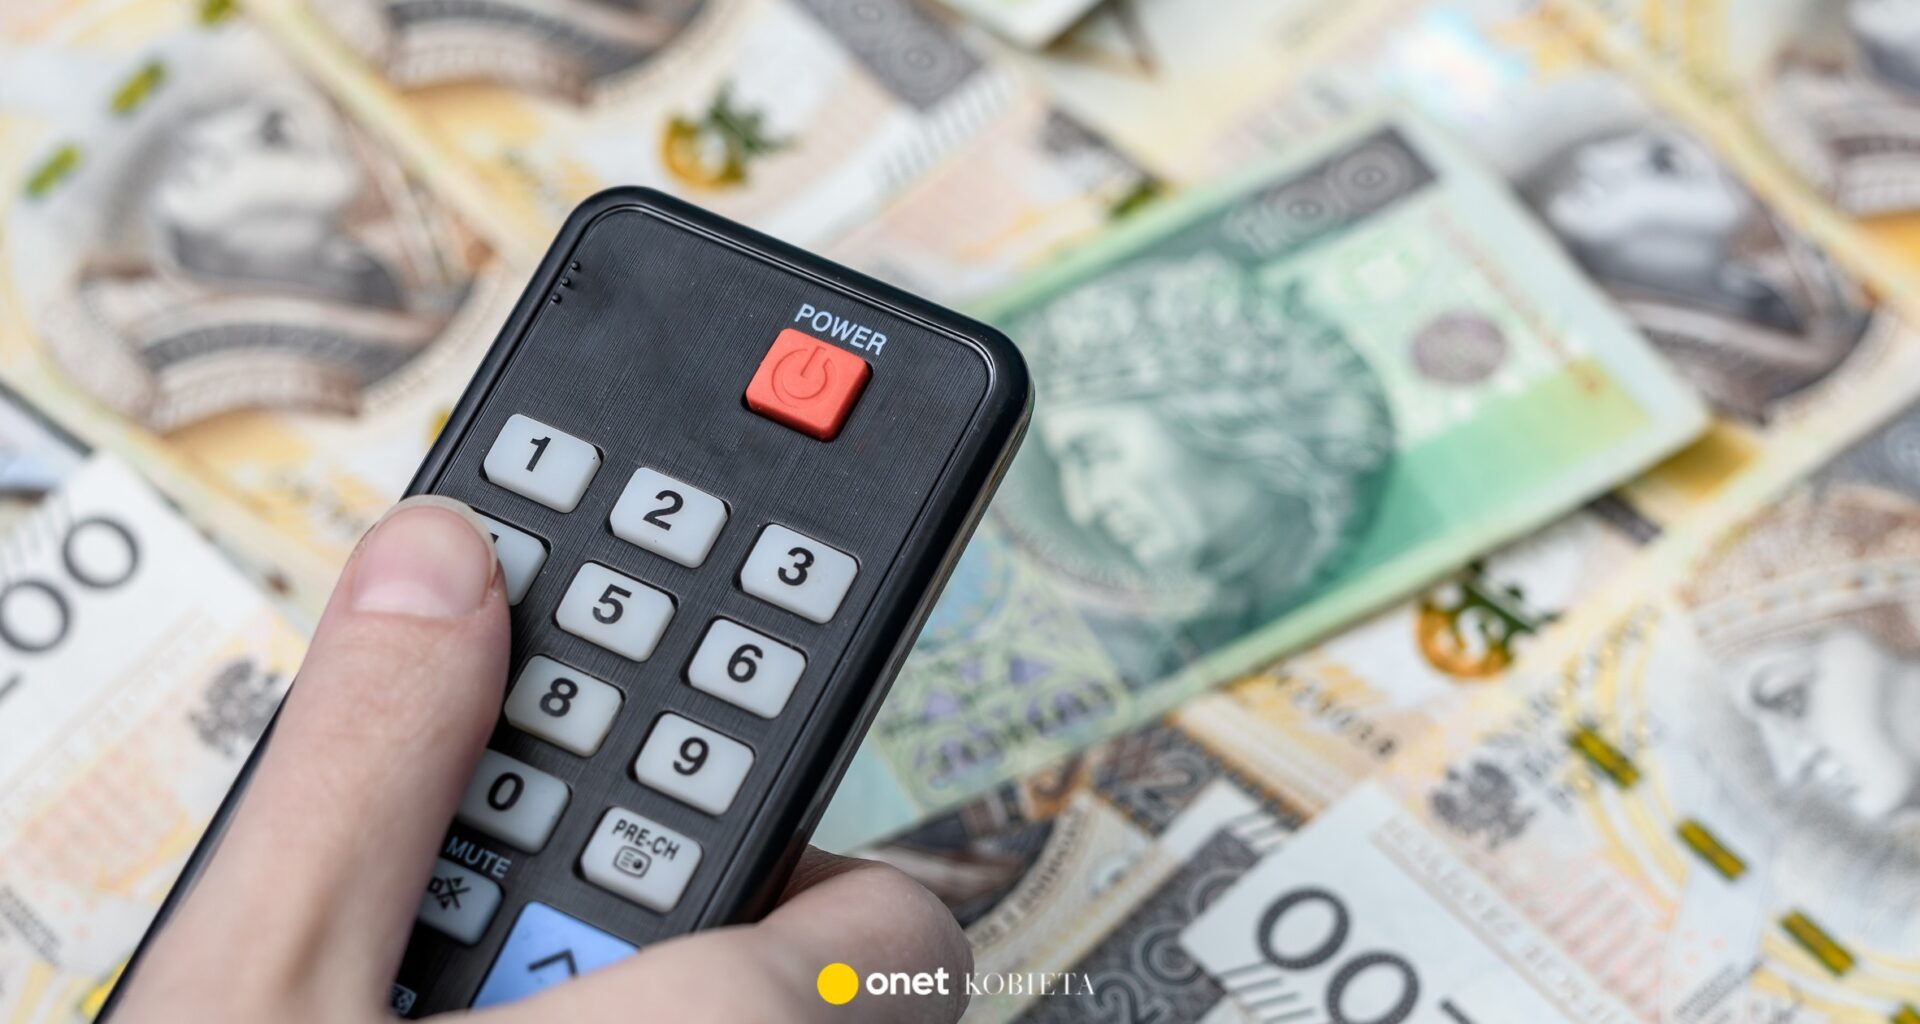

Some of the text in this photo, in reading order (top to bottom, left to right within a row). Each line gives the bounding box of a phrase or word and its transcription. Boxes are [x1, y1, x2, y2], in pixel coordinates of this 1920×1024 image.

[794, 303, 887, 355] POWER
[525, 436, 552, 473] 1
[642, 489, 684, 532] 2
[777, 547, 815, 587] 3
[592, 584, 633, 625] 5
[726, 643, 764, 684] 6
[539, 677, 579, 718] 8
[672, 737, 710, 777] 9
[487, 771, 525, 811] 0
[446, 836, 511, 879] MUTE
[611, 818, 681, 861] PRE-CH
